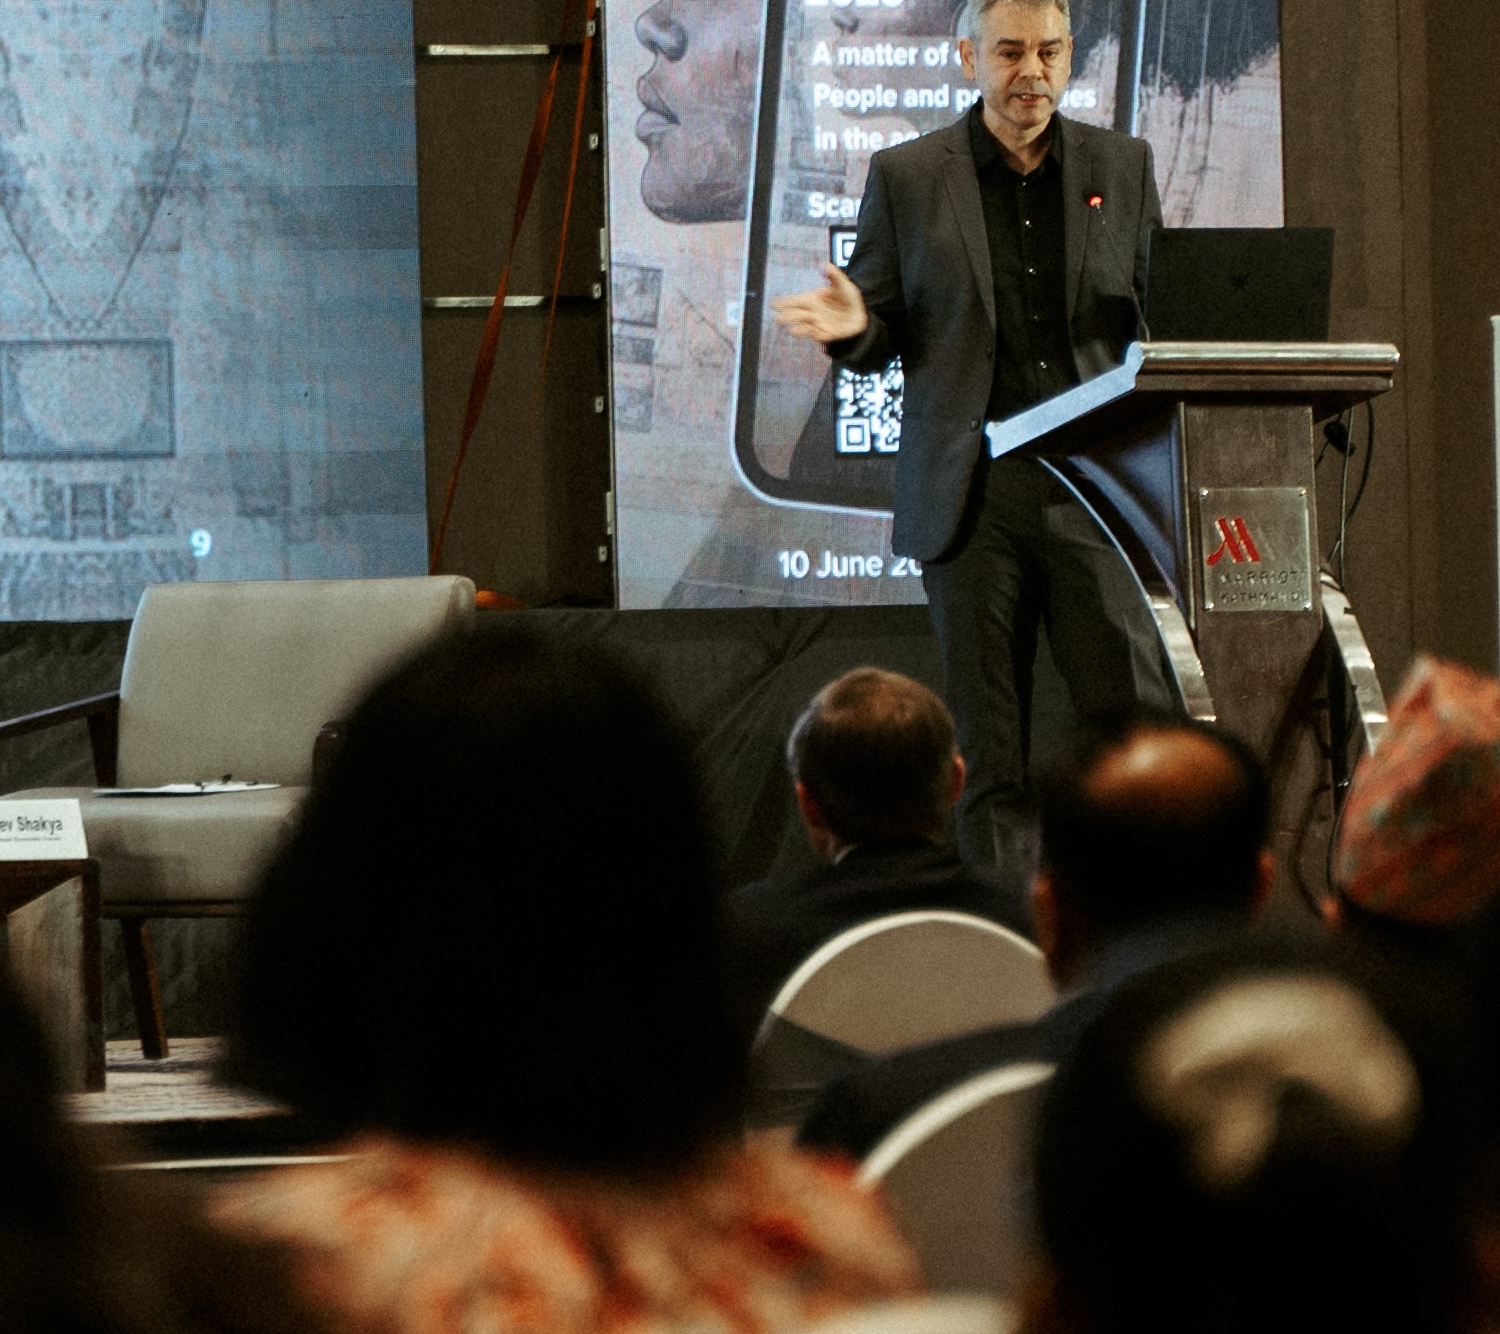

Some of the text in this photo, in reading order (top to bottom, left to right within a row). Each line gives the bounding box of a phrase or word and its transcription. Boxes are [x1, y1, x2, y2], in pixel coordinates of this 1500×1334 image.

[812, 41, 832, 66] A
[838, 43, 917, 67] matter
[921, 41, 950, 67] of
[813, 83, 898, 113] People
[903, 84, 950, 108] and
[815, 125, 837, 150] in
[842, 126, 884, 151] the
[190, 528, 212, 558] 9
[778, 550, 810, 579] 10
[815, 550, 884, 579] June
[16, 816, 63, 835] Shakya
